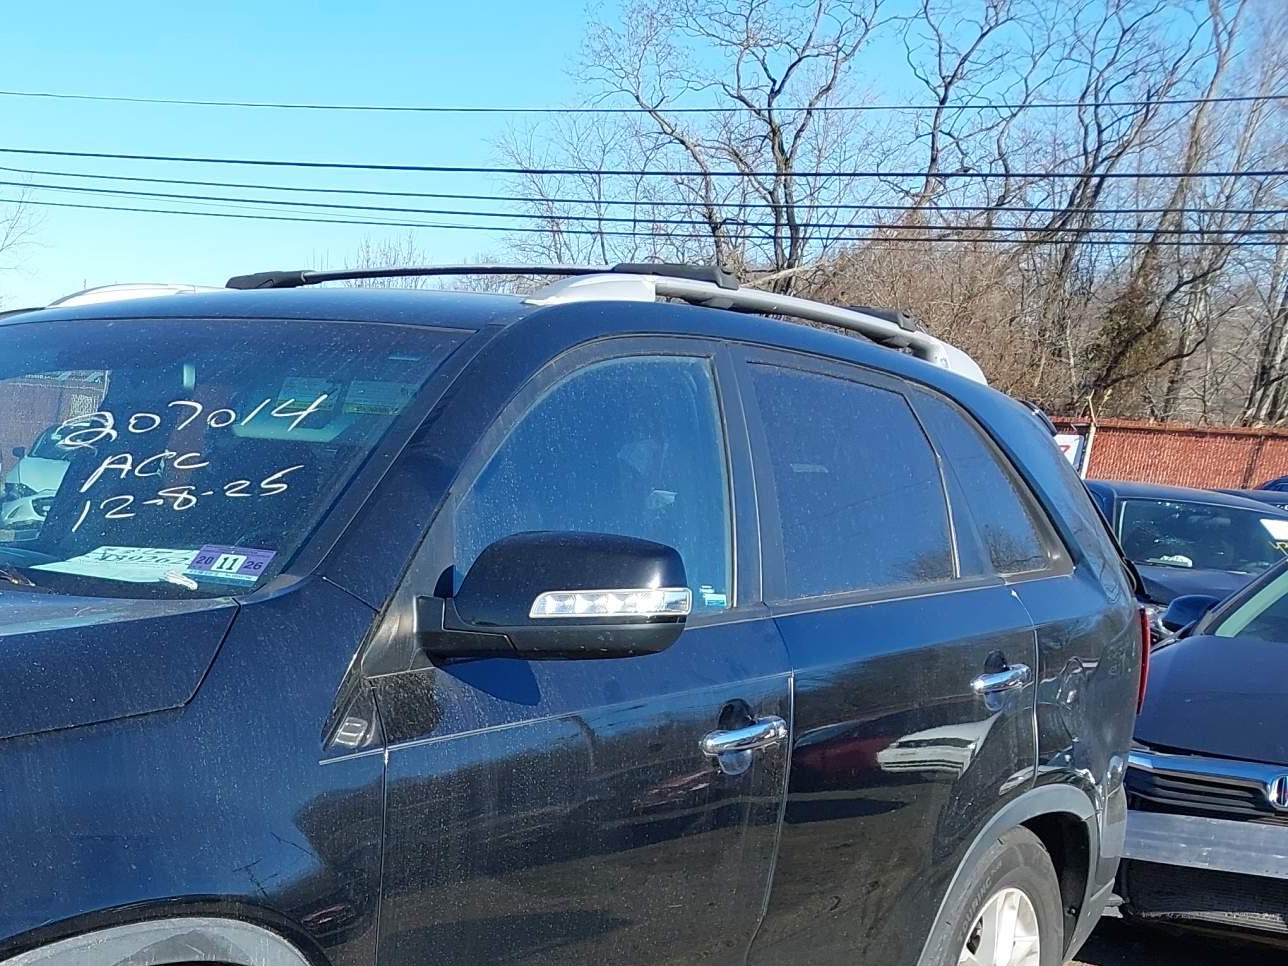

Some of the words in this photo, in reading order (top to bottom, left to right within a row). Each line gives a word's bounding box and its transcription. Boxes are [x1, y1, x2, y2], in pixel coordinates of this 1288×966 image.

[55, 393, 329, 452] 207014
[79, 450, 210, 493] ACC
[71, 464, 305, 533] 12-8-25
[196, 555, 214, 565] 20
[215, 556, 239, 571] 11
[243, 561, 264, 570] 26
